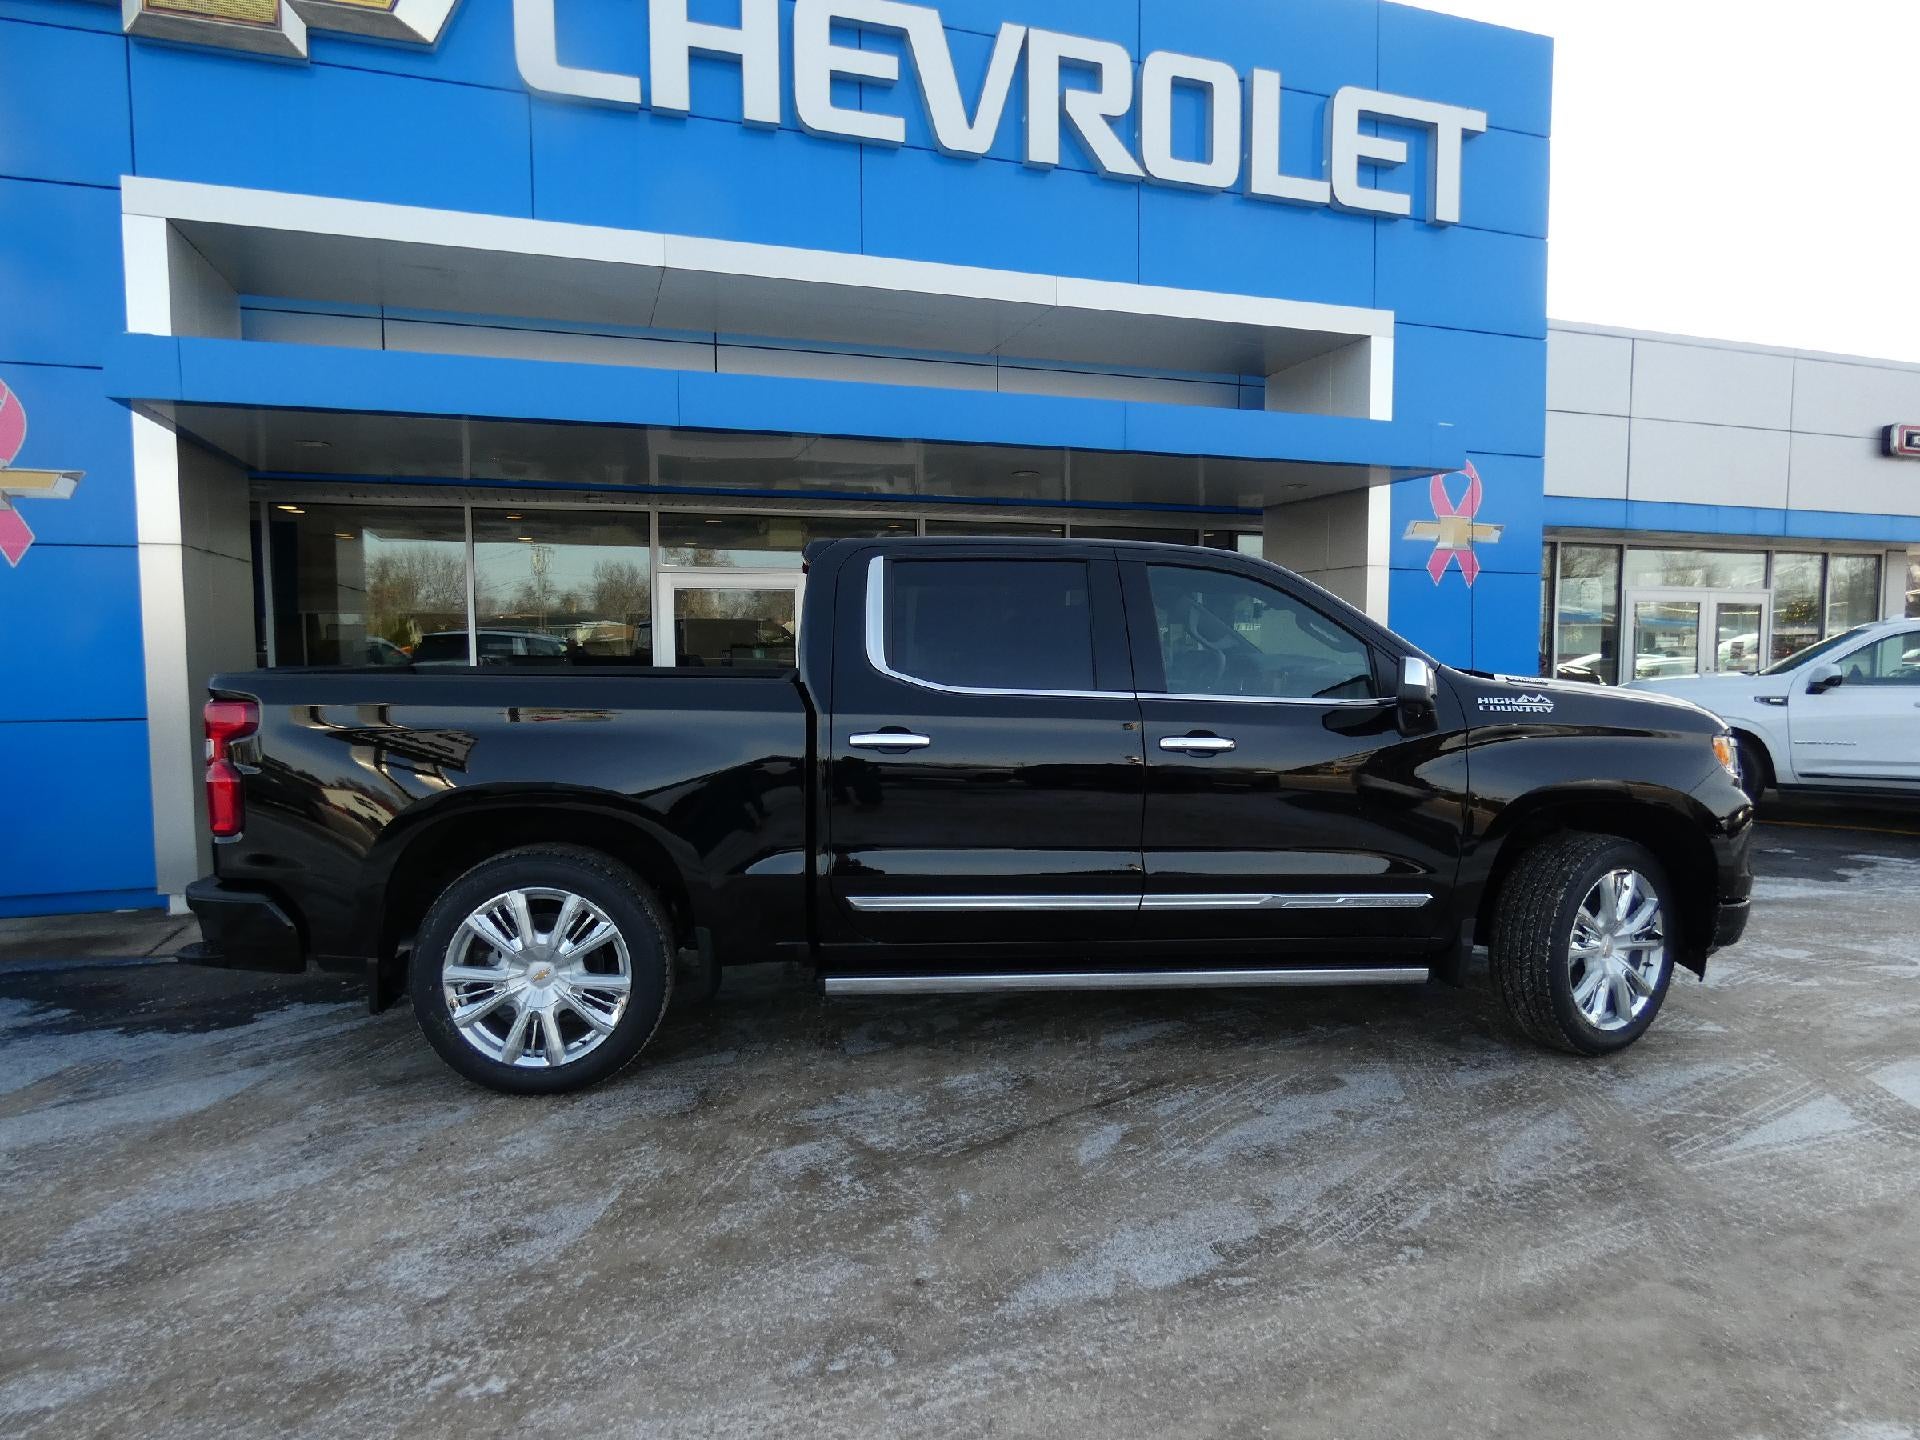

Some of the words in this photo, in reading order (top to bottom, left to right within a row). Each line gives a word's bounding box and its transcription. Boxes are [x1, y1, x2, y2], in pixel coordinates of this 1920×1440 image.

[513, 0, 1487, 226] CHEVROLET
[1477, 697, 1516, 705] HIGH
[1478, 704, 1554, 713] COUNTRY
